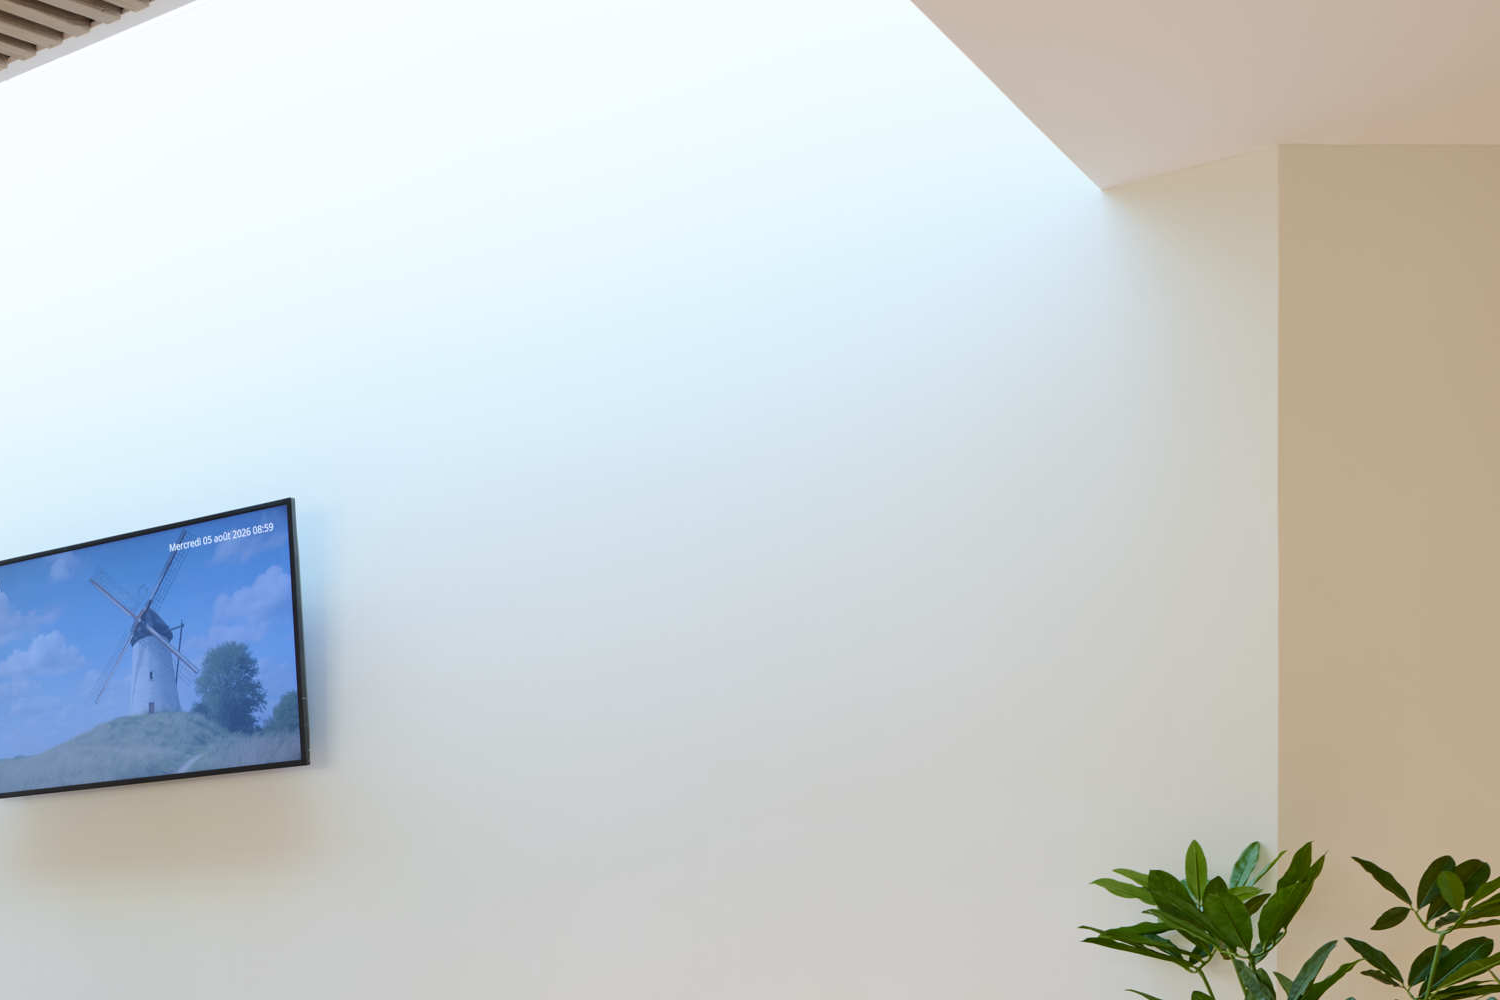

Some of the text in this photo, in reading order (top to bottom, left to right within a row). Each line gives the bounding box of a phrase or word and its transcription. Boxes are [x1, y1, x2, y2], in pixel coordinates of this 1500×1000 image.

[169, 522, 274, 552] Mercredi 05 août 2026 08:59
